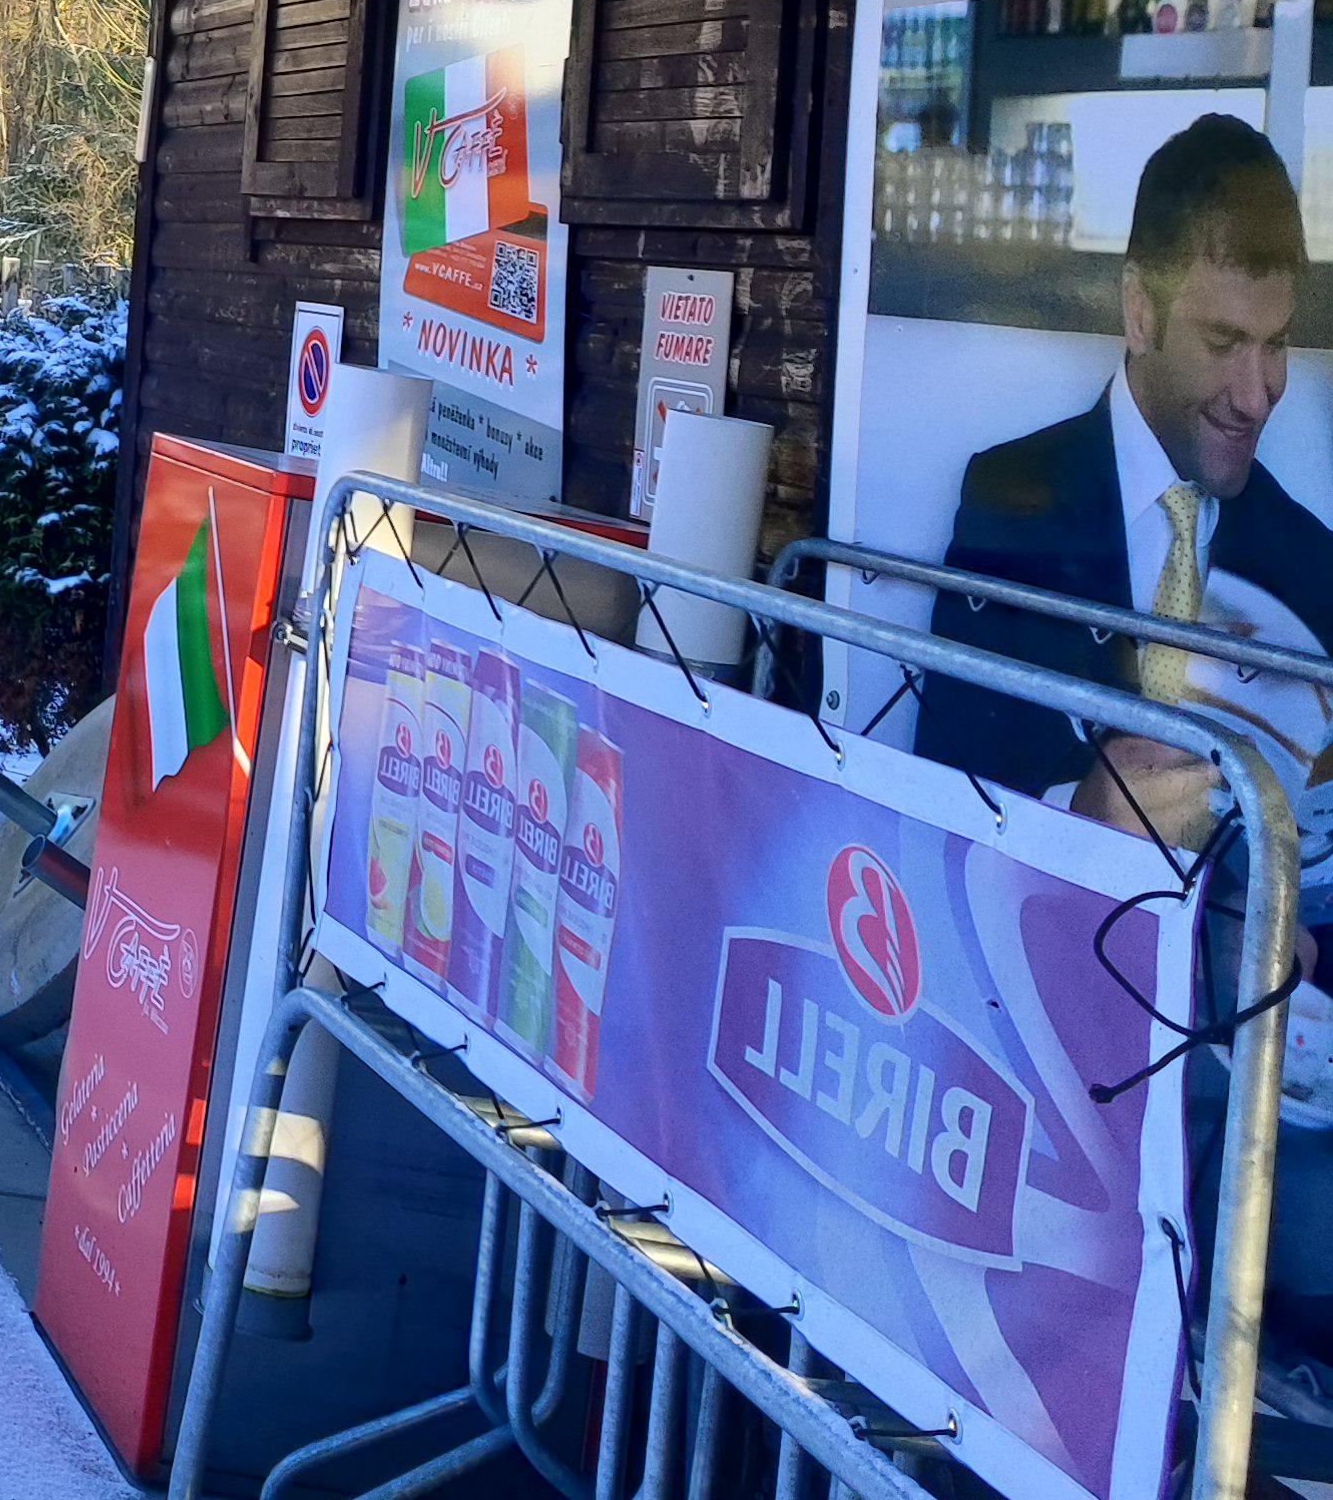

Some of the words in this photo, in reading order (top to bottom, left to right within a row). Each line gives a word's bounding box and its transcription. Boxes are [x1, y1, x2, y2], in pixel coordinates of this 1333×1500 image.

[656, 332, 714, 365] FUMARE
[660, 292, 715, 325] VIETATO
[418, 318, 514, 387] NOVINKA
[61, 1053, 105, 1146] Gelateria
[84, 1081, 139, 1177] Pasticceria
[118, 1112, 176, 1224] Caffetteria
